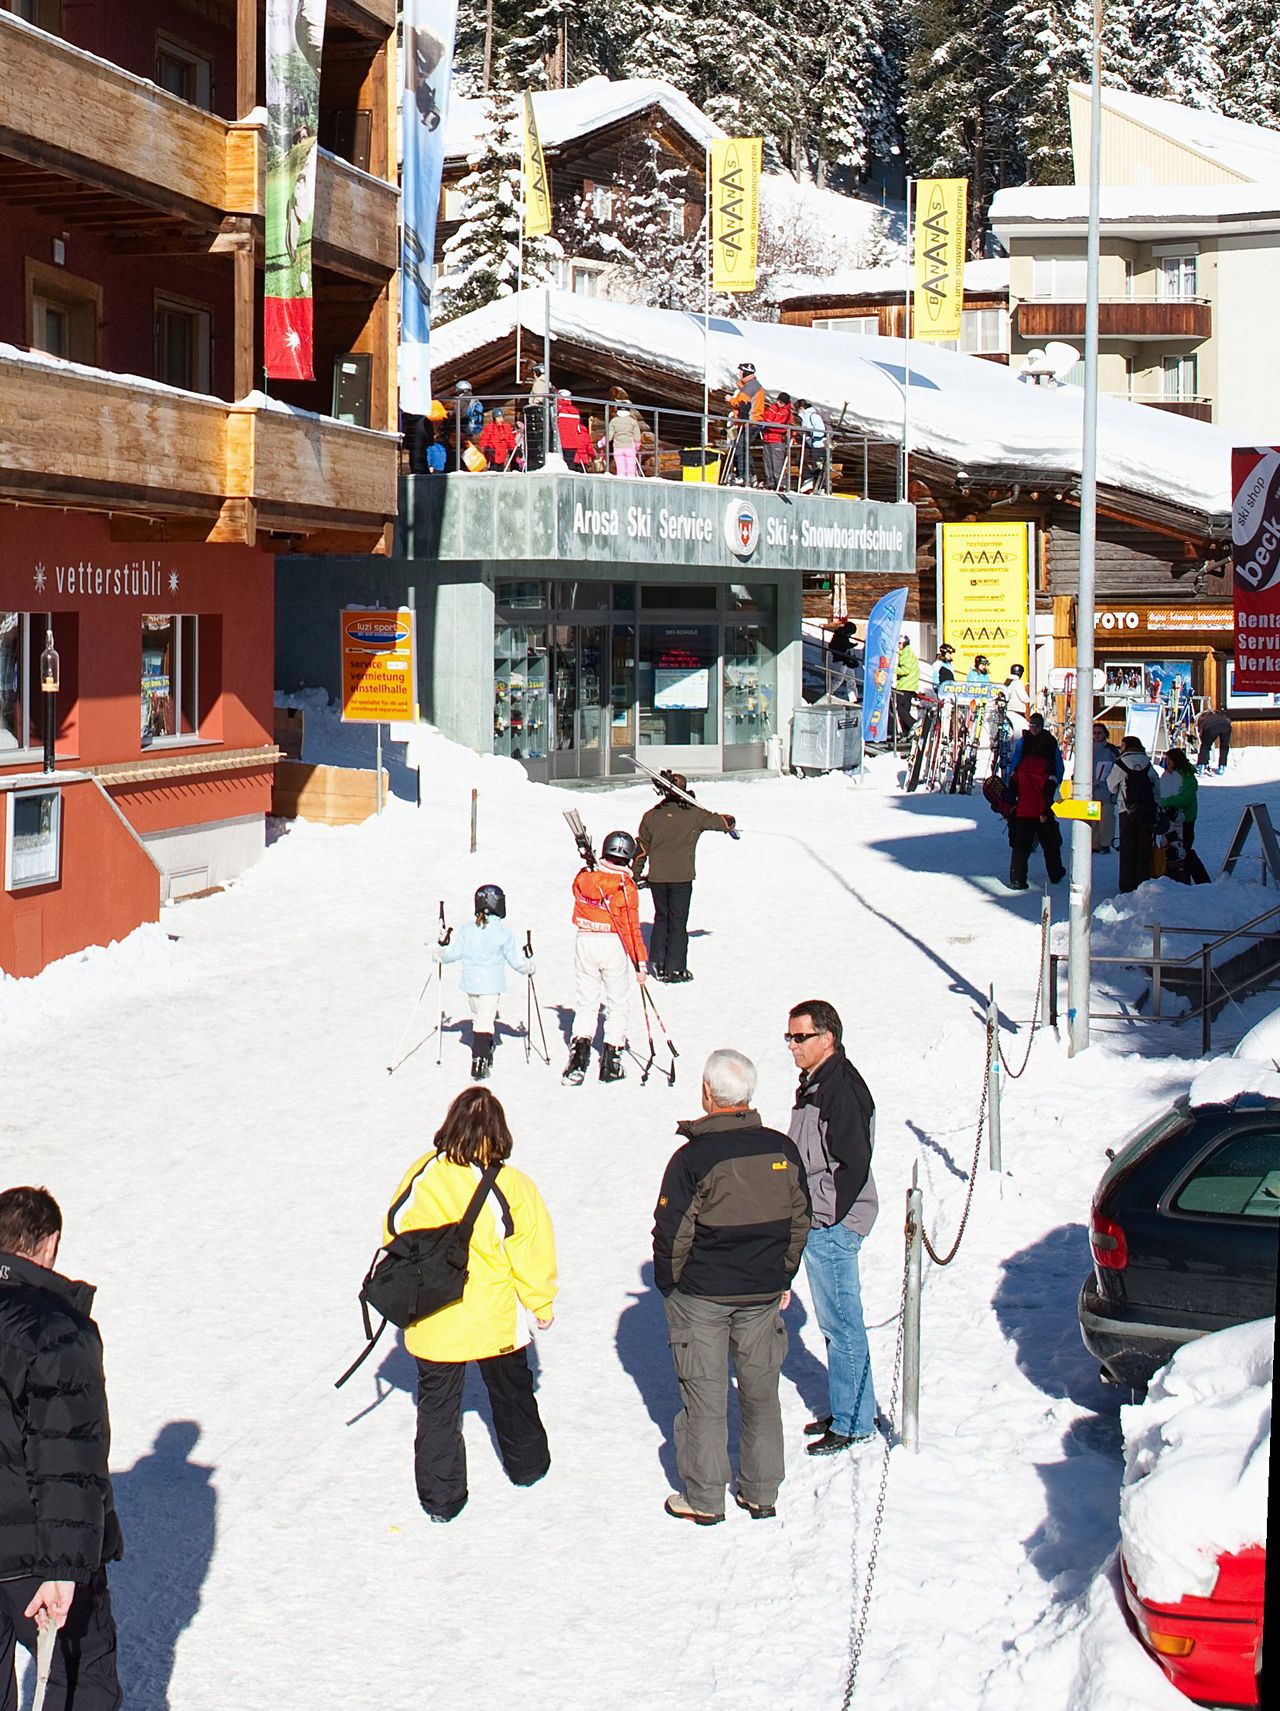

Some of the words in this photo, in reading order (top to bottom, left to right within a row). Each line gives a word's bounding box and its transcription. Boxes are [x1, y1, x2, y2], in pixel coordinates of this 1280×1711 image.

[1237, 506, 1250, 527] ski
[1246, 476, 1265, 508] shop
[573, 502, 619, 537] Arosa
[627, 505, 651, 538] Ski
[659, 508, 713, 542] Service
[766, 517, 787, 546] Ski
[790, 529, 799, 546] +
[800, 519, 903, 552] Snowboardschule
[55, 560, 162, 596] vetterstübli
[357, 621, 372, 631] luzi
[374, 622, 396, 633] sport
[1094, 611, 1140, 630] FOTO
[1238, 633, 1280, 649] Servi
[350, 659, 382, 669] service
[350, 672, 405, 683] vermietung
[350, 684, 407, 695] einstellhalle
